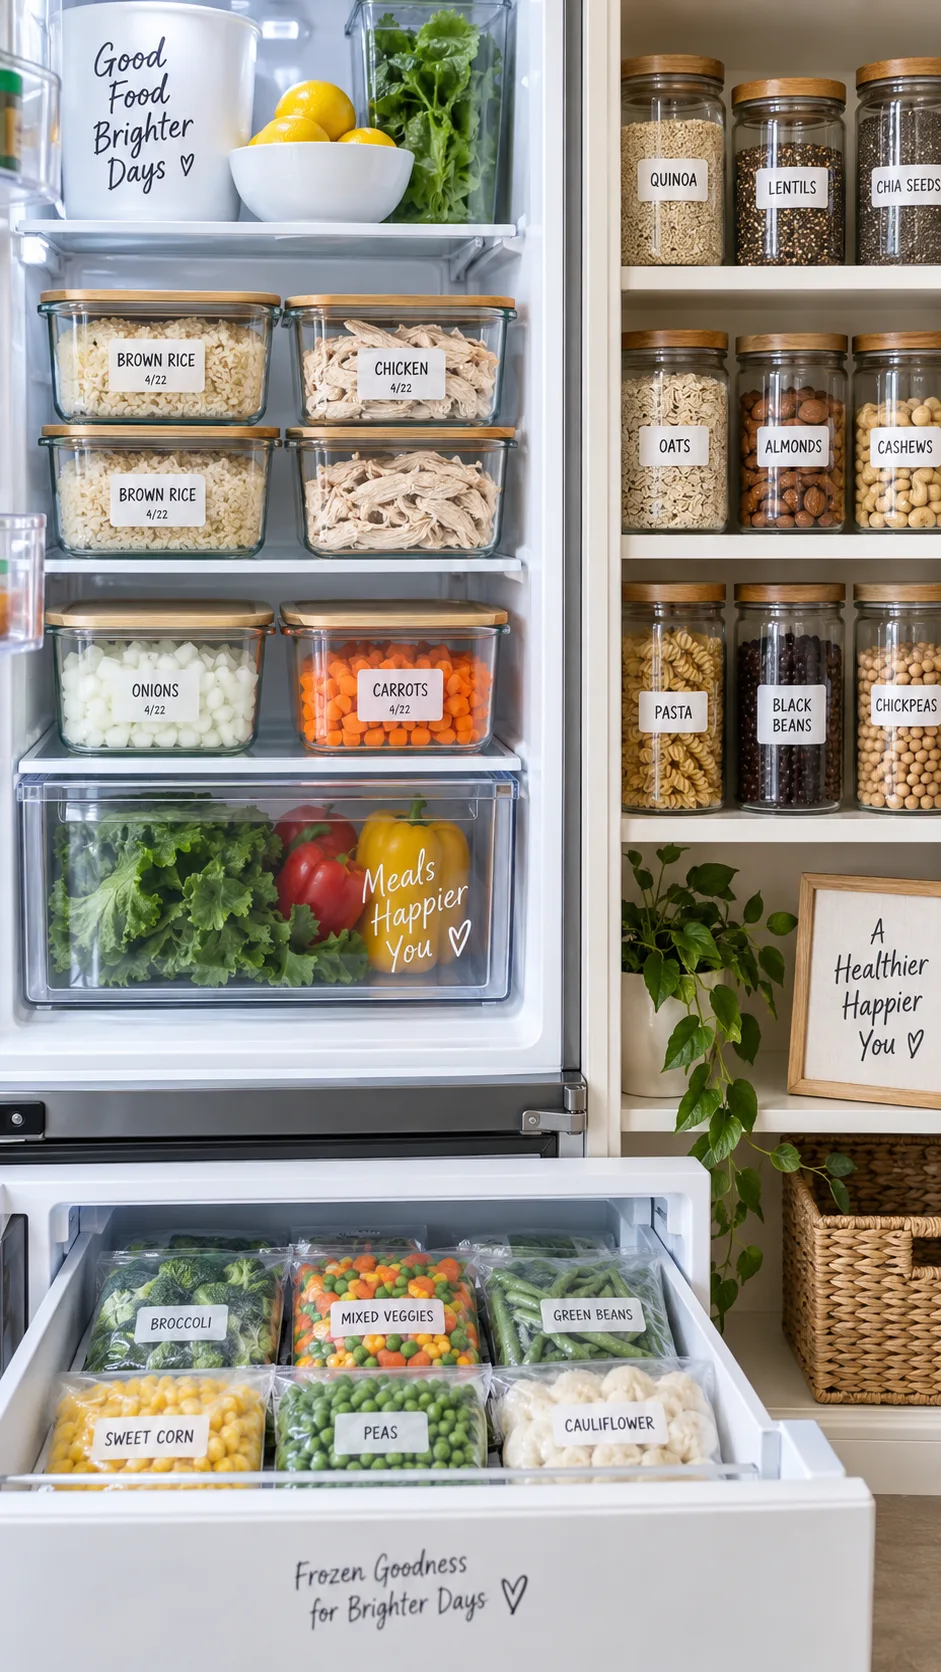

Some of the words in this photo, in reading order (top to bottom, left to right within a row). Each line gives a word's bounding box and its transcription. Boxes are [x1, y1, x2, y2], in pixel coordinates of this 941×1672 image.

[94, 36, 168, 78] Good
[108, 72, 171, 115] Food
[93, 111, 195, 159] Brighter
[107, 156, 166, 195] Days
[650, 172, 698, 188] QUINOA
[768, 180, 817, 196] LENTILS
[876, 179, 902, 195] CHIA
[906, 177, 941, 193] SEEDS
[117, 352, 163, 368] BROWN
[167, 352, 196, 368] RICE
[374, 361, 429, 376] CHICKEN
[144, 374, 167, 386] 4/22
[390, 382, 412, 394] 4/22
[659, 438, 691, 454] OATS
[764, 438, 823, 454] ALMONDS
[877, 439, 933, 455] CASHEWS
[119, 487, 164, 503] BROWN
[169, 487, 197, 502] RICE
[146, 509, 168, 521] 4/22
[131, 683, 179, 698] ONIONS
[372, 682, 428, 698] CARROTS
[144, 704, 166, 716] 4/22
[389, 703, 411, 716] 4/22
[655, 705, 693, 720] PASTA
[773, 697, 812, 713] BLACK
[875, 697, 938, 713] CHICKPEAS
[772, 718, 812, 733] BEANS
[362, 847, 436, 904] Meals
[370, 885, 469, 937] Happier
[870, 917, 885, 946] A
[385, 934, 433, 973] You
[834, 948, 930, 985] Healthier
[841, 989, 924, 1027] Happier
[858, 1028, 896, 1062] You
[341, 1310, 379, 1325] MIXED
[383, 1309, 434, 1323] VEGGIES
[553, 1309, 592, 1322] GREEN
[595, 1308, 634, 1321] BEANS
[150, 1316, 212, 1331] BROCCOLI
[564, 1415, 655, 1433] CAULIFLOWER
[104, 1429, 152, 1447] SWEET
[156, 1429, 194, 1445] CORN
[364, 1425, 398, 1441] PEAS
[295, 1561, 366, 1591] Frozen
[373, 1548, 467, 1588] Goodness
[309, 1596, 339, 1631] for
[348, 1590, 429, 1631] Brighter
[437, 1586, 488, 1622] Days
